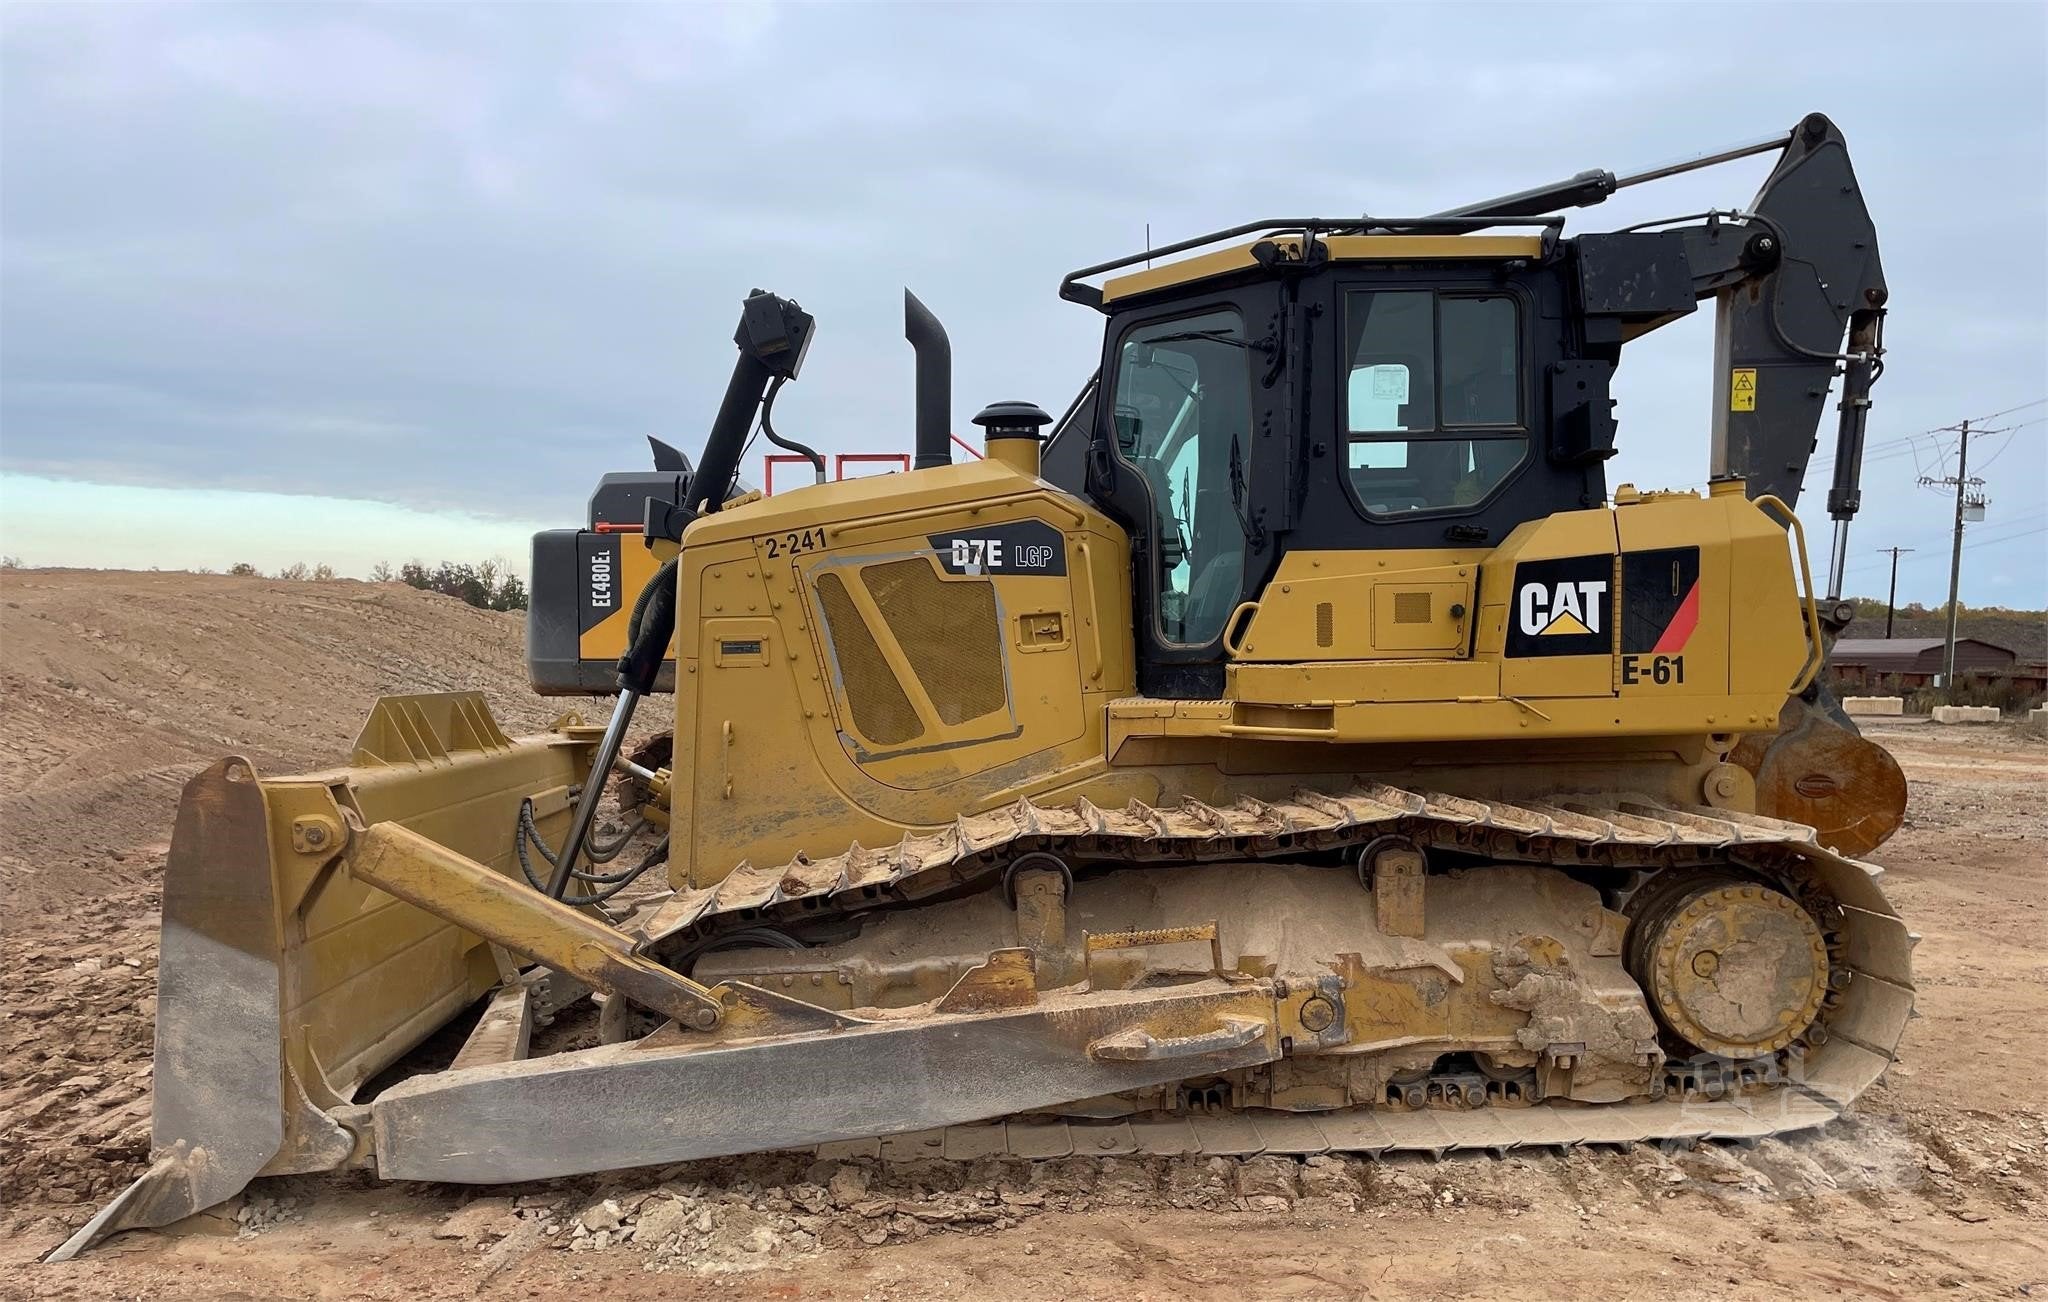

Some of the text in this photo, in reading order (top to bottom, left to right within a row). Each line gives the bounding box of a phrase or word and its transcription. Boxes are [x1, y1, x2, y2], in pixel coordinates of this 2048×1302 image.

[765, 527, 827, 559] 2-241
[951, 539, 1053, 568] D7E LGP
[1519, 580, 1607, 636] CAT
[1622, 655, 1684, 685] E-61
